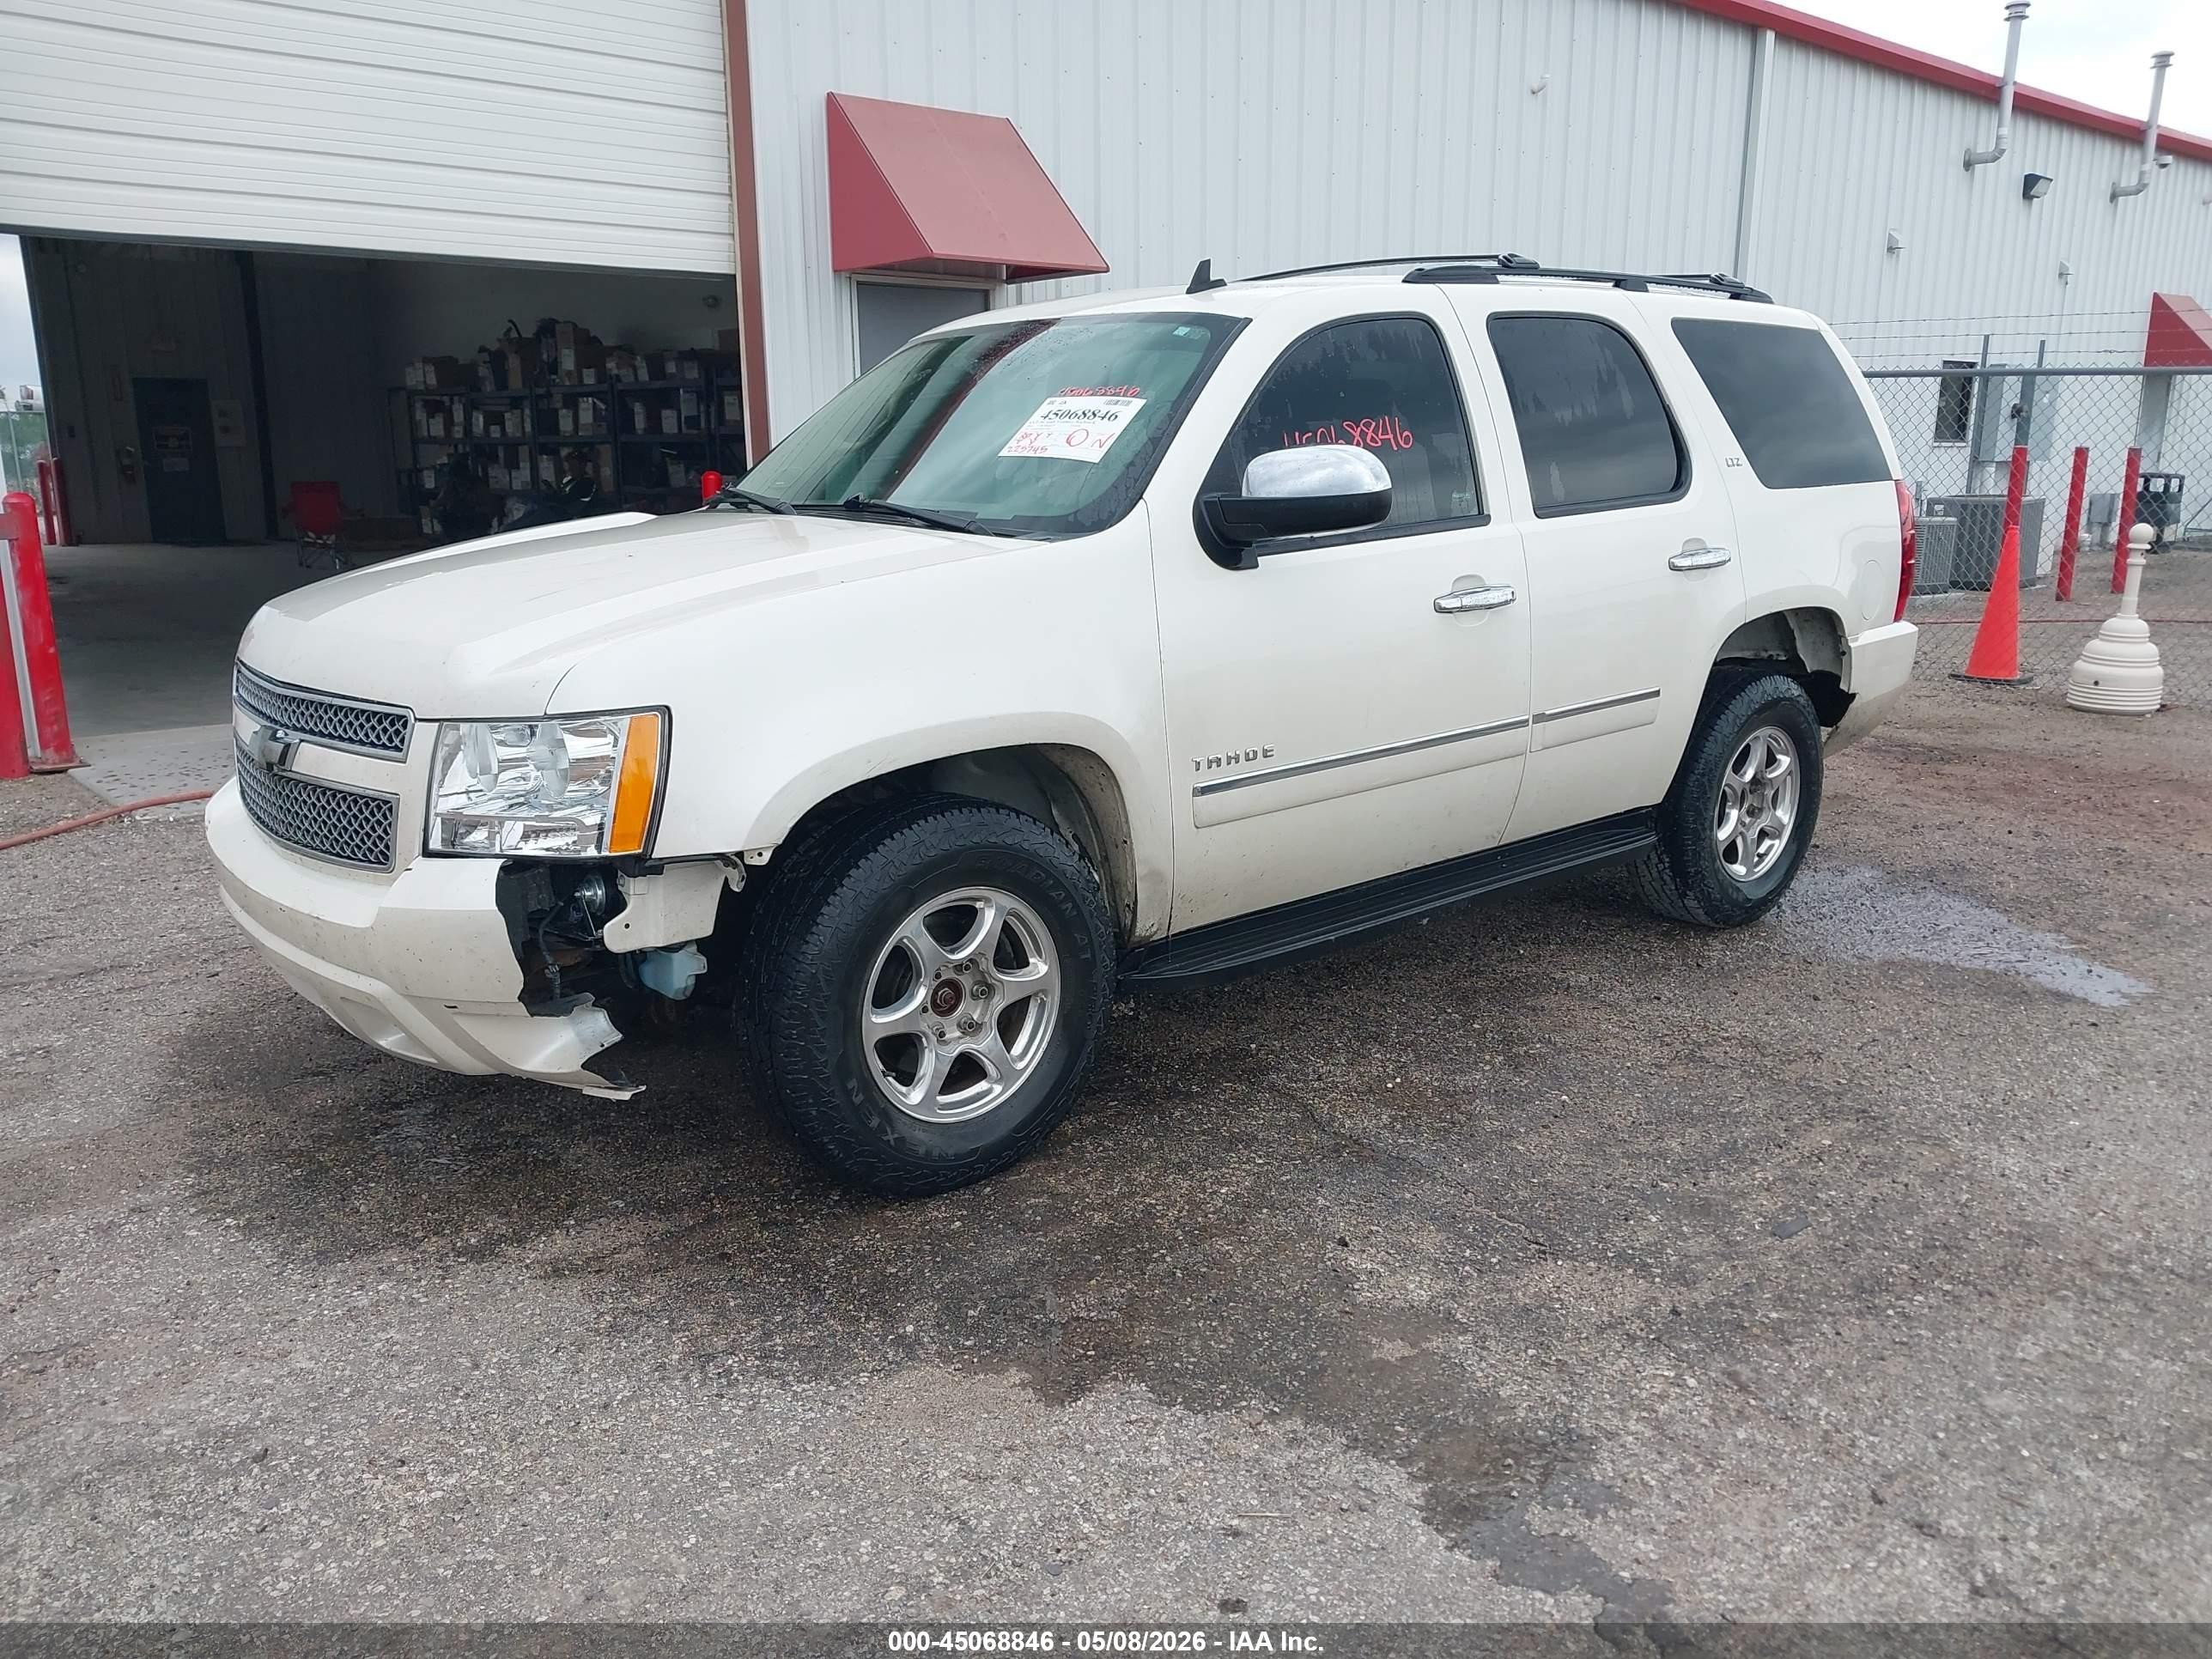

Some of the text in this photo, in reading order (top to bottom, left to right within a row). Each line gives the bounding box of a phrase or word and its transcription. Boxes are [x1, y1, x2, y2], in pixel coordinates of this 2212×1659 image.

[1040, 408, 1121, 422] 45068846
[1725, 457, 1743, 467] LTZ
[1191, 744, 1275, 772] TAHOE
[844, 1078, 956, 1160] NEXEN
